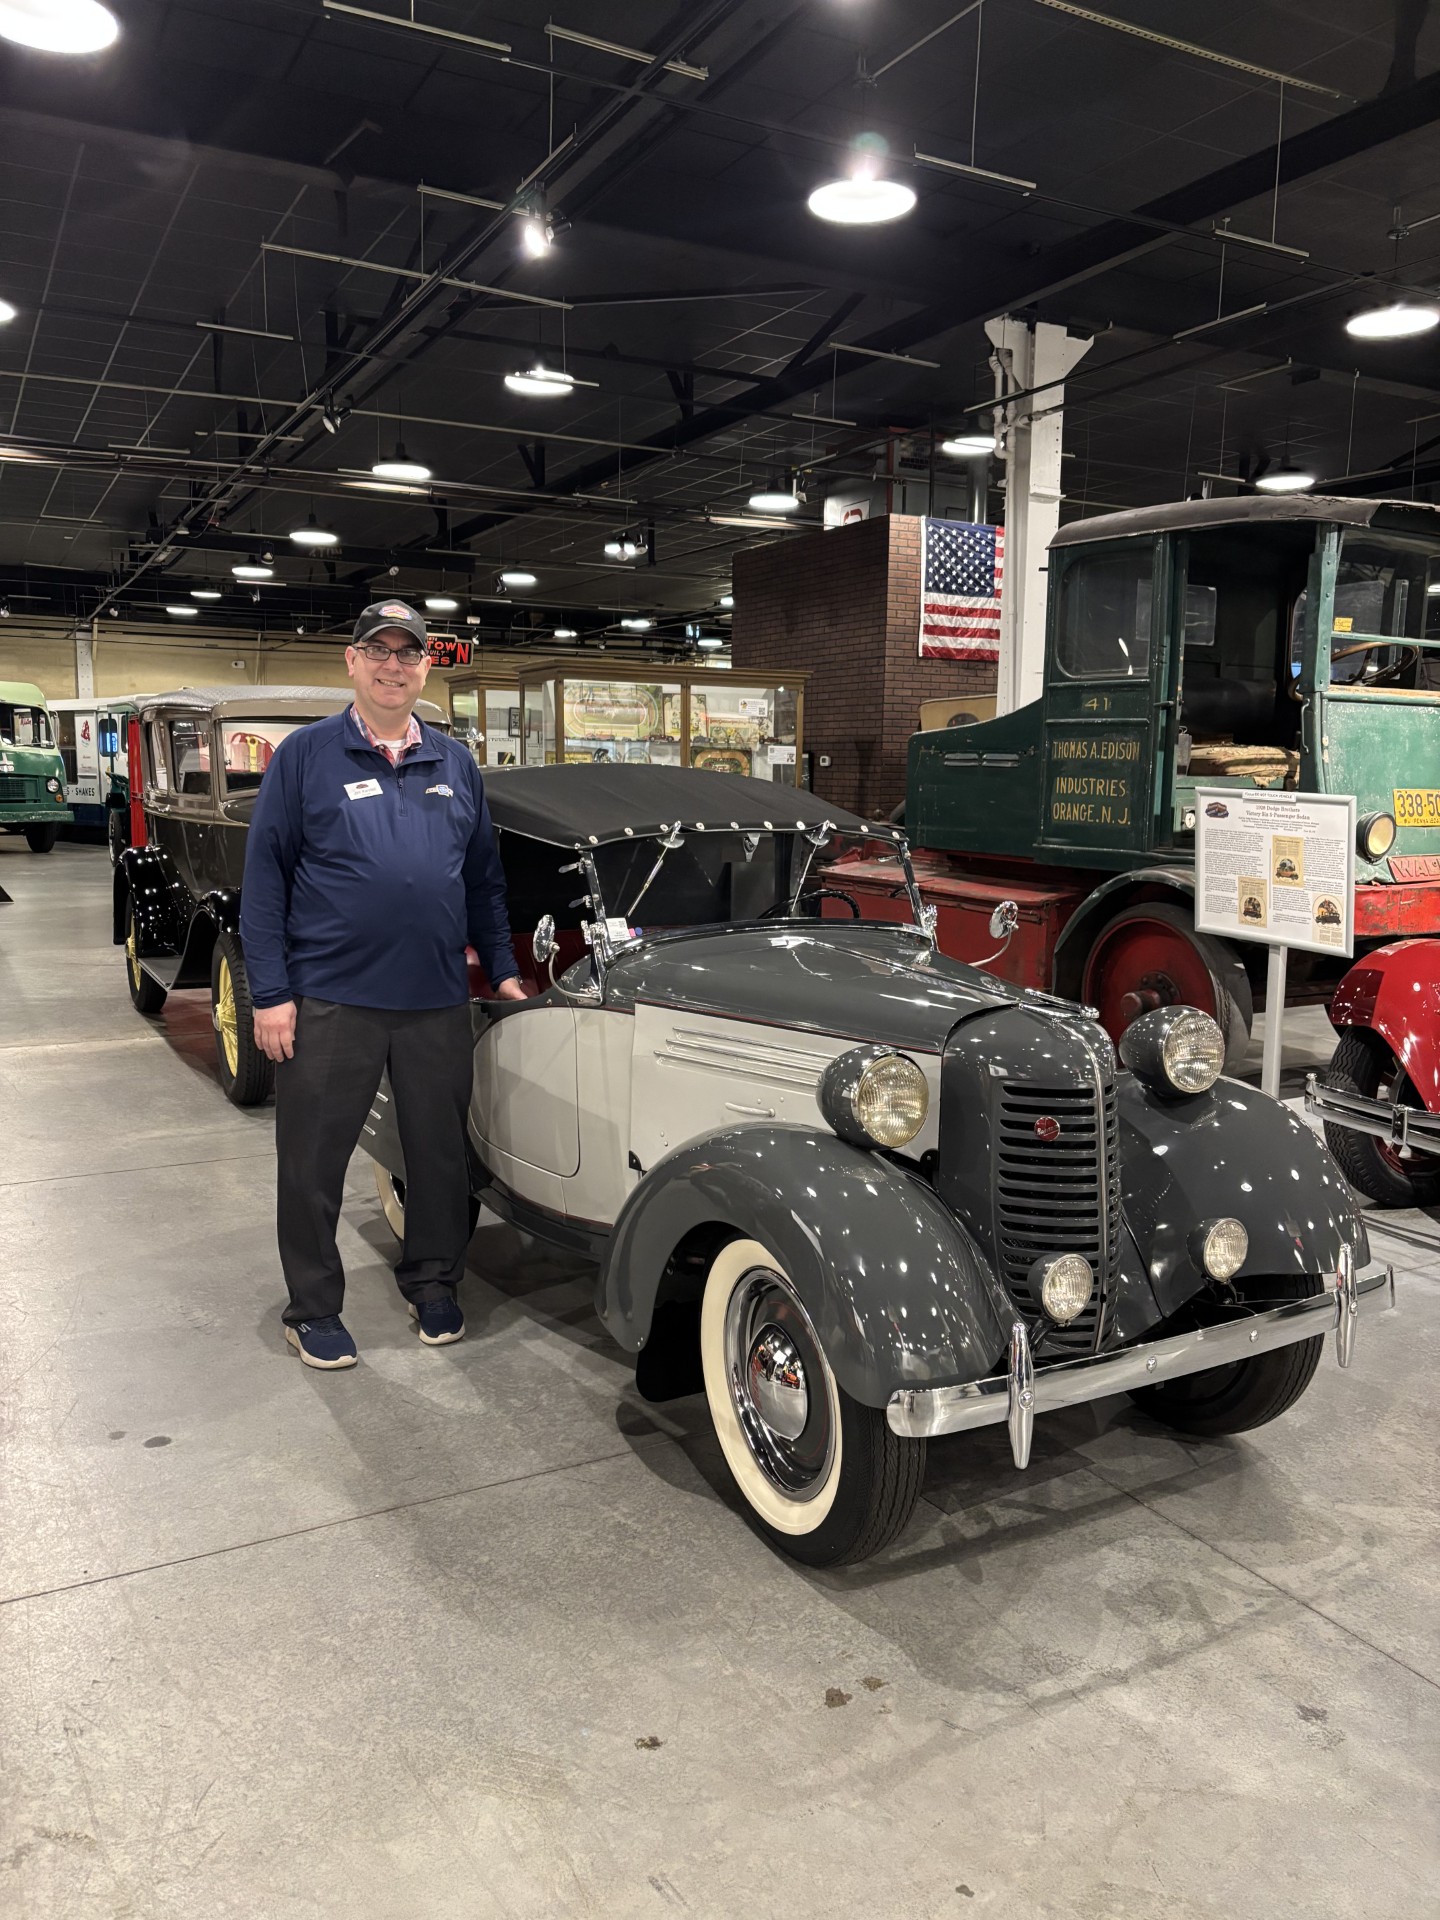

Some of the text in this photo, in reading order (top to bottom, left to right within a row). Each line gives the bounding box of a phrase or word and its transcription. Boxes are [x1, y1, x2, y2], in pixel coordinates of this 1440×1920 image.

[1085, 698, 1109, 711] 41
[1053, 741, 1088, 759] THOMAS
[75, 787, 95, 797] SHAKES
[1056, 777, 1127, 797] INDUSTRIES
